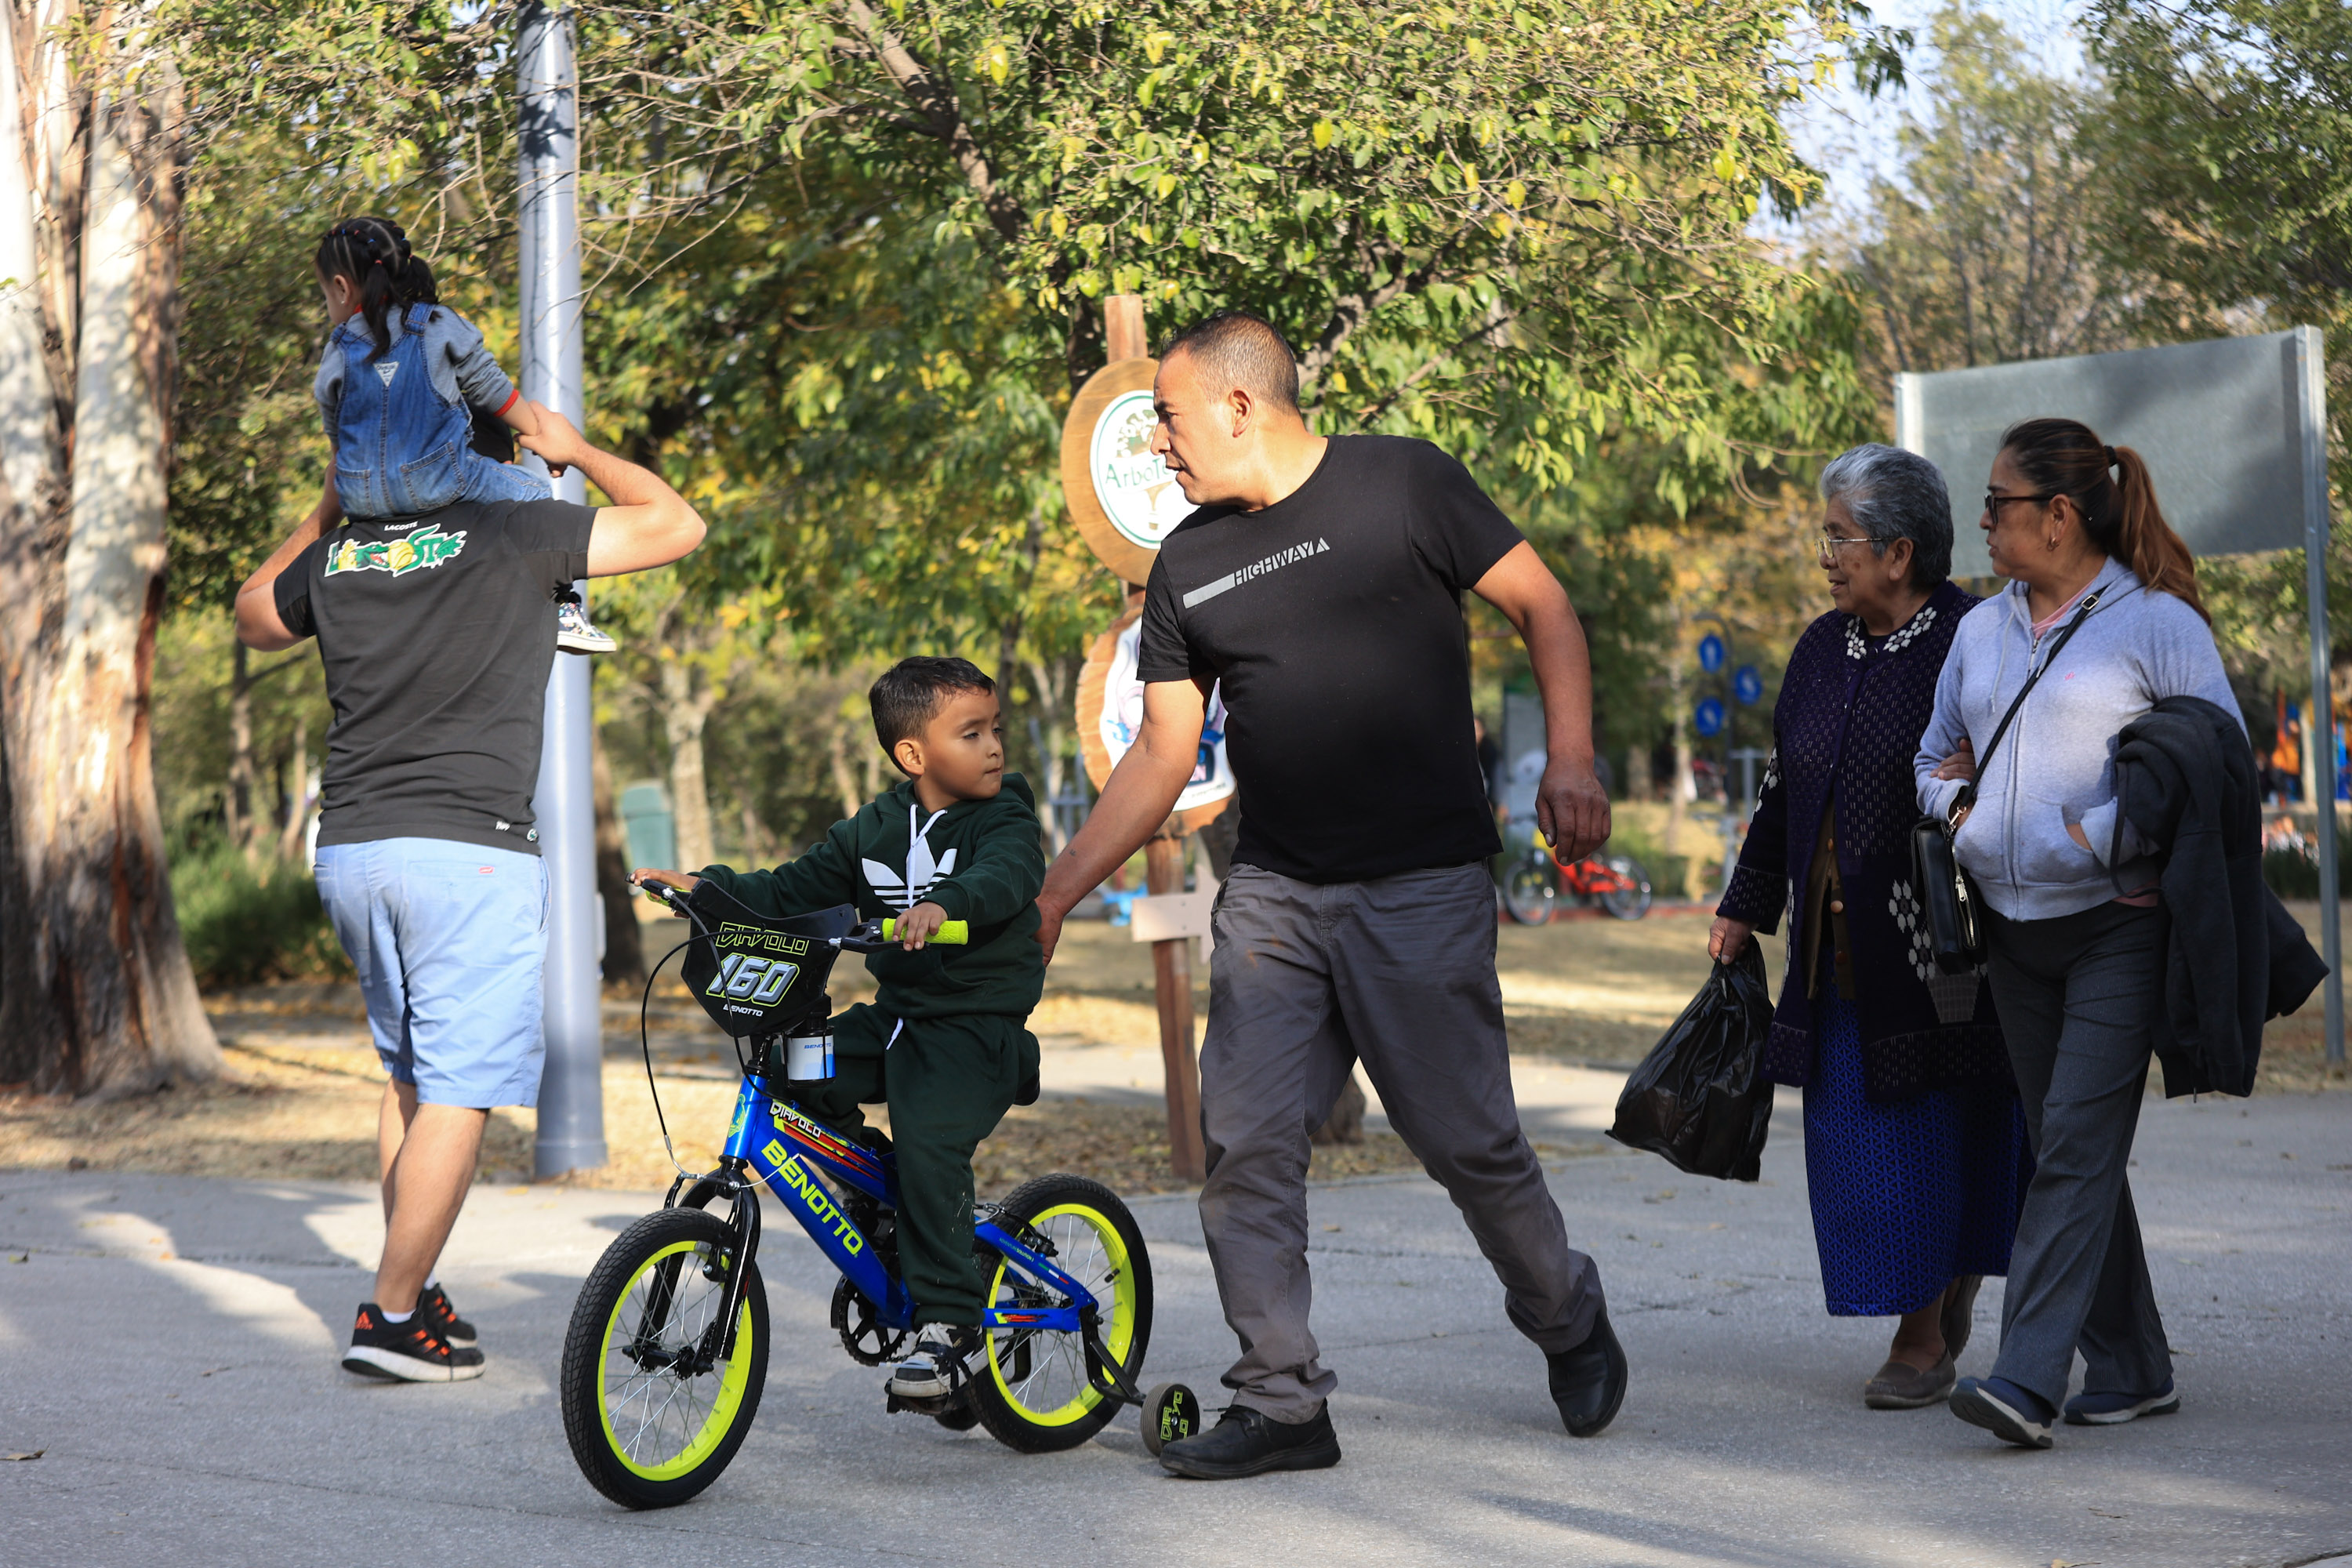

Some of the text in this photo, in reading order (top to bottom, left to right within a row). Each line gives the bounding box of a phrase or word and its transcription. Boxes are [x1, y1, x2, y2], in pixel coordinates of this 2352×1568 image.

[384, 521, 419, 532] LACOSTE
[706, 952, 800, 1007] 160
[769, 1102, 822, 1138] DIAVOLO
[760, 1138, 863, 1255] BENOTTO
